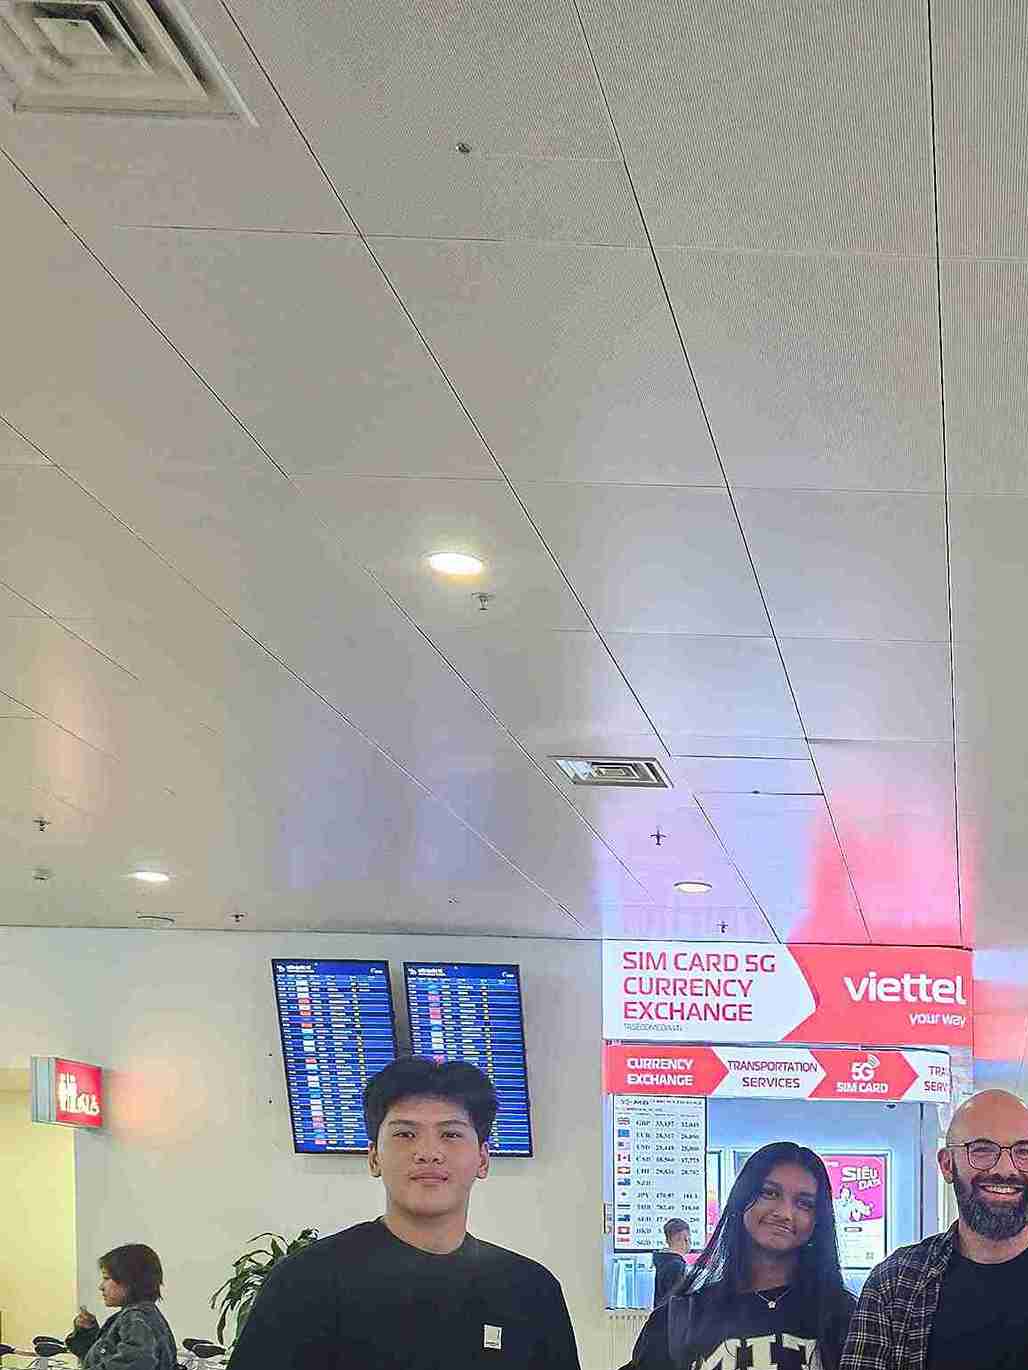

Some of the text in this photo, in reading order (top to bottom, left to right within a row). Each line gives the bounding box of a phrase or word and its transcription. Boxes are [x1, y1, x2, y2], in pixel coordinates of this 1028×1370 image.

[623, 951, 776, 973] SIM CARD 5G
[623, 977, 753, 998] CURRENCY
[843, 971, 967, 1005] viettel
[623, 1001, 753, 1021] EXCHANGE
[909, 1013, 967, 1028] your way
[626, 1058, 694, 1070] CURRENCY
[727, 1060, 818, 1073] TRANSPORTATION
[851, 1061, 876, 1081] 5G
[626, 1073, 695, 1087] EXCHANGE
[742, 1077, 801, 1089] SERVICES
[836, 1081, 889, 1094] SIM CARD
